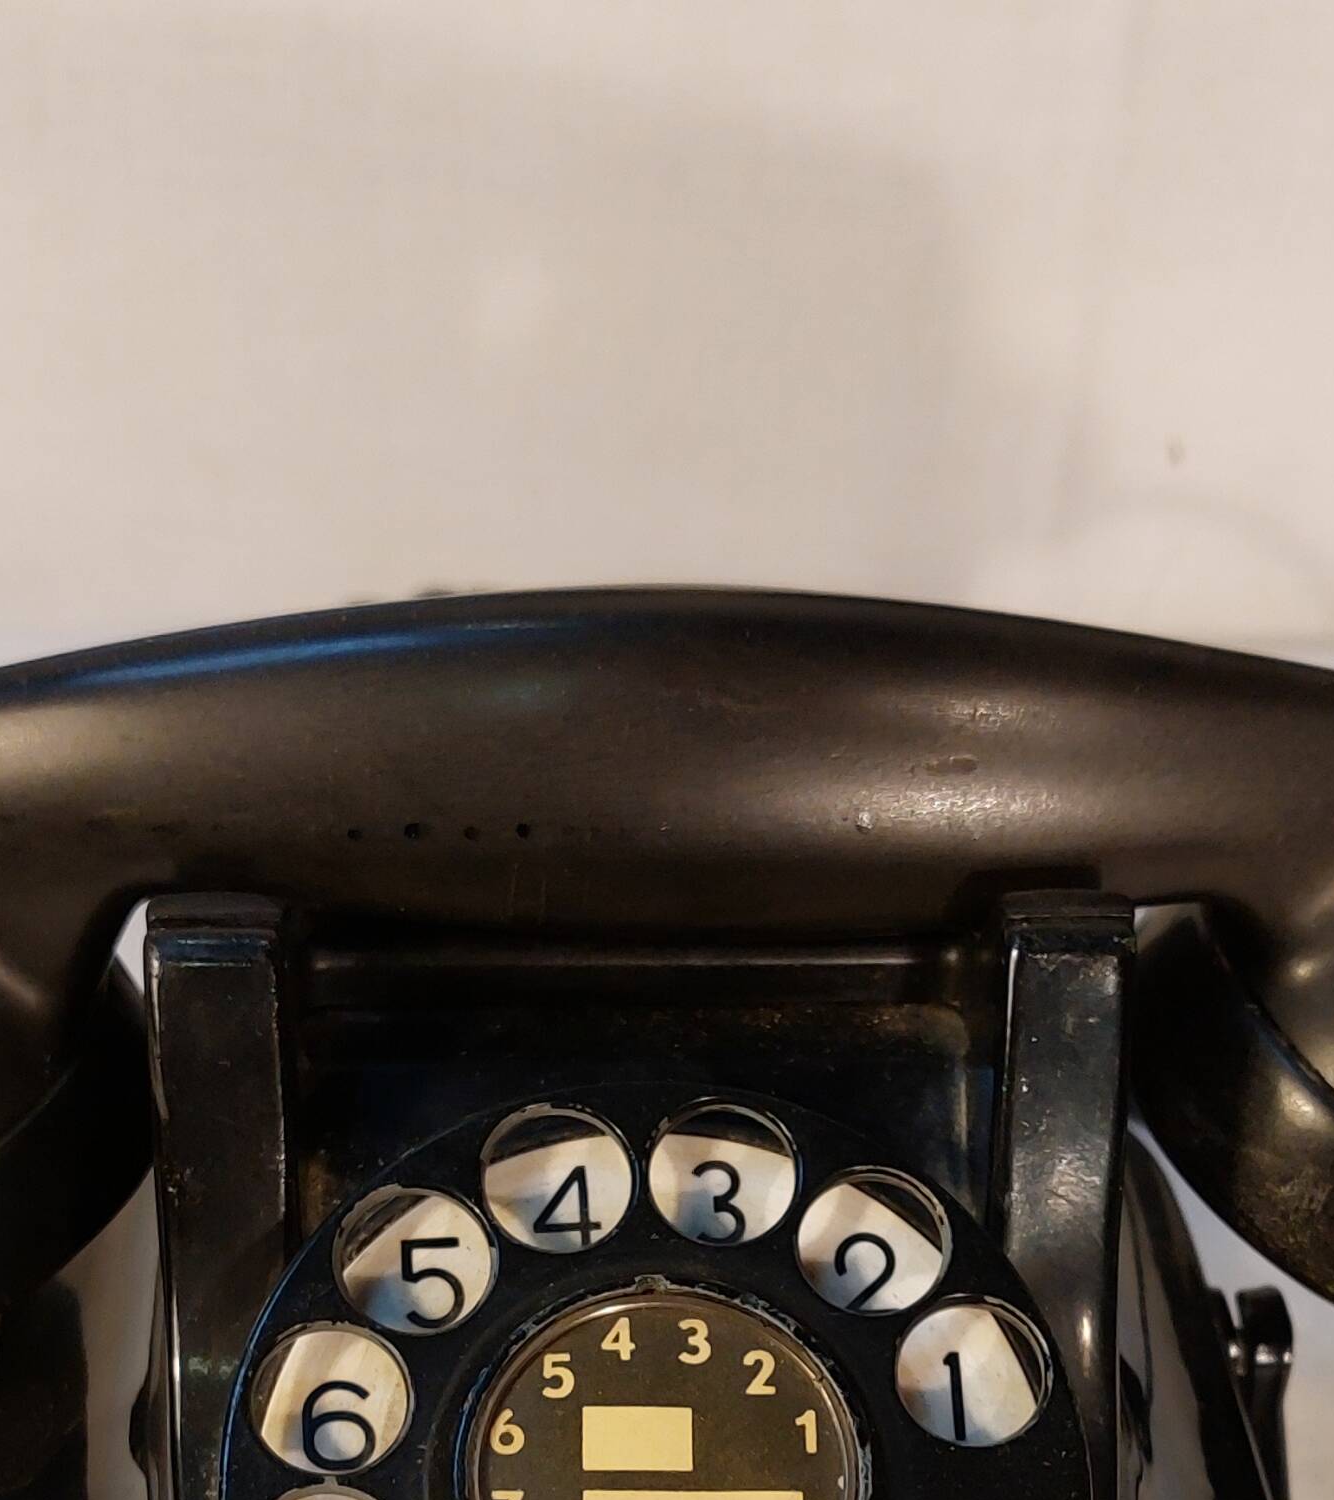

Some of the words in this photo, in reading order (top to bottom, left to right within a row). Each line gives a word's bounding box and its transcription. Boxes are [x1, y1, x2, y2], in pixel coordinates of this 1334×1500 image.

[533, 1165, 602, 1247] 4
[691, 1160, 746, 1242] 3
[400, 1236, 465, 1329] 5
[834, 1232, 900, 1312] 2
[600, 1316, 636, 1361] 4
[677, 1318, 712, 1365] 3
[541, 1352, 576, 1399] 5
[742, 1349, 776, 1396] 2
[942, 1350, 967, 1442] 1
[301, 1380, 377, 1471] 6
[489, 1408, 525, 1456] 6
[794, 1409, 818, 1454] 1
